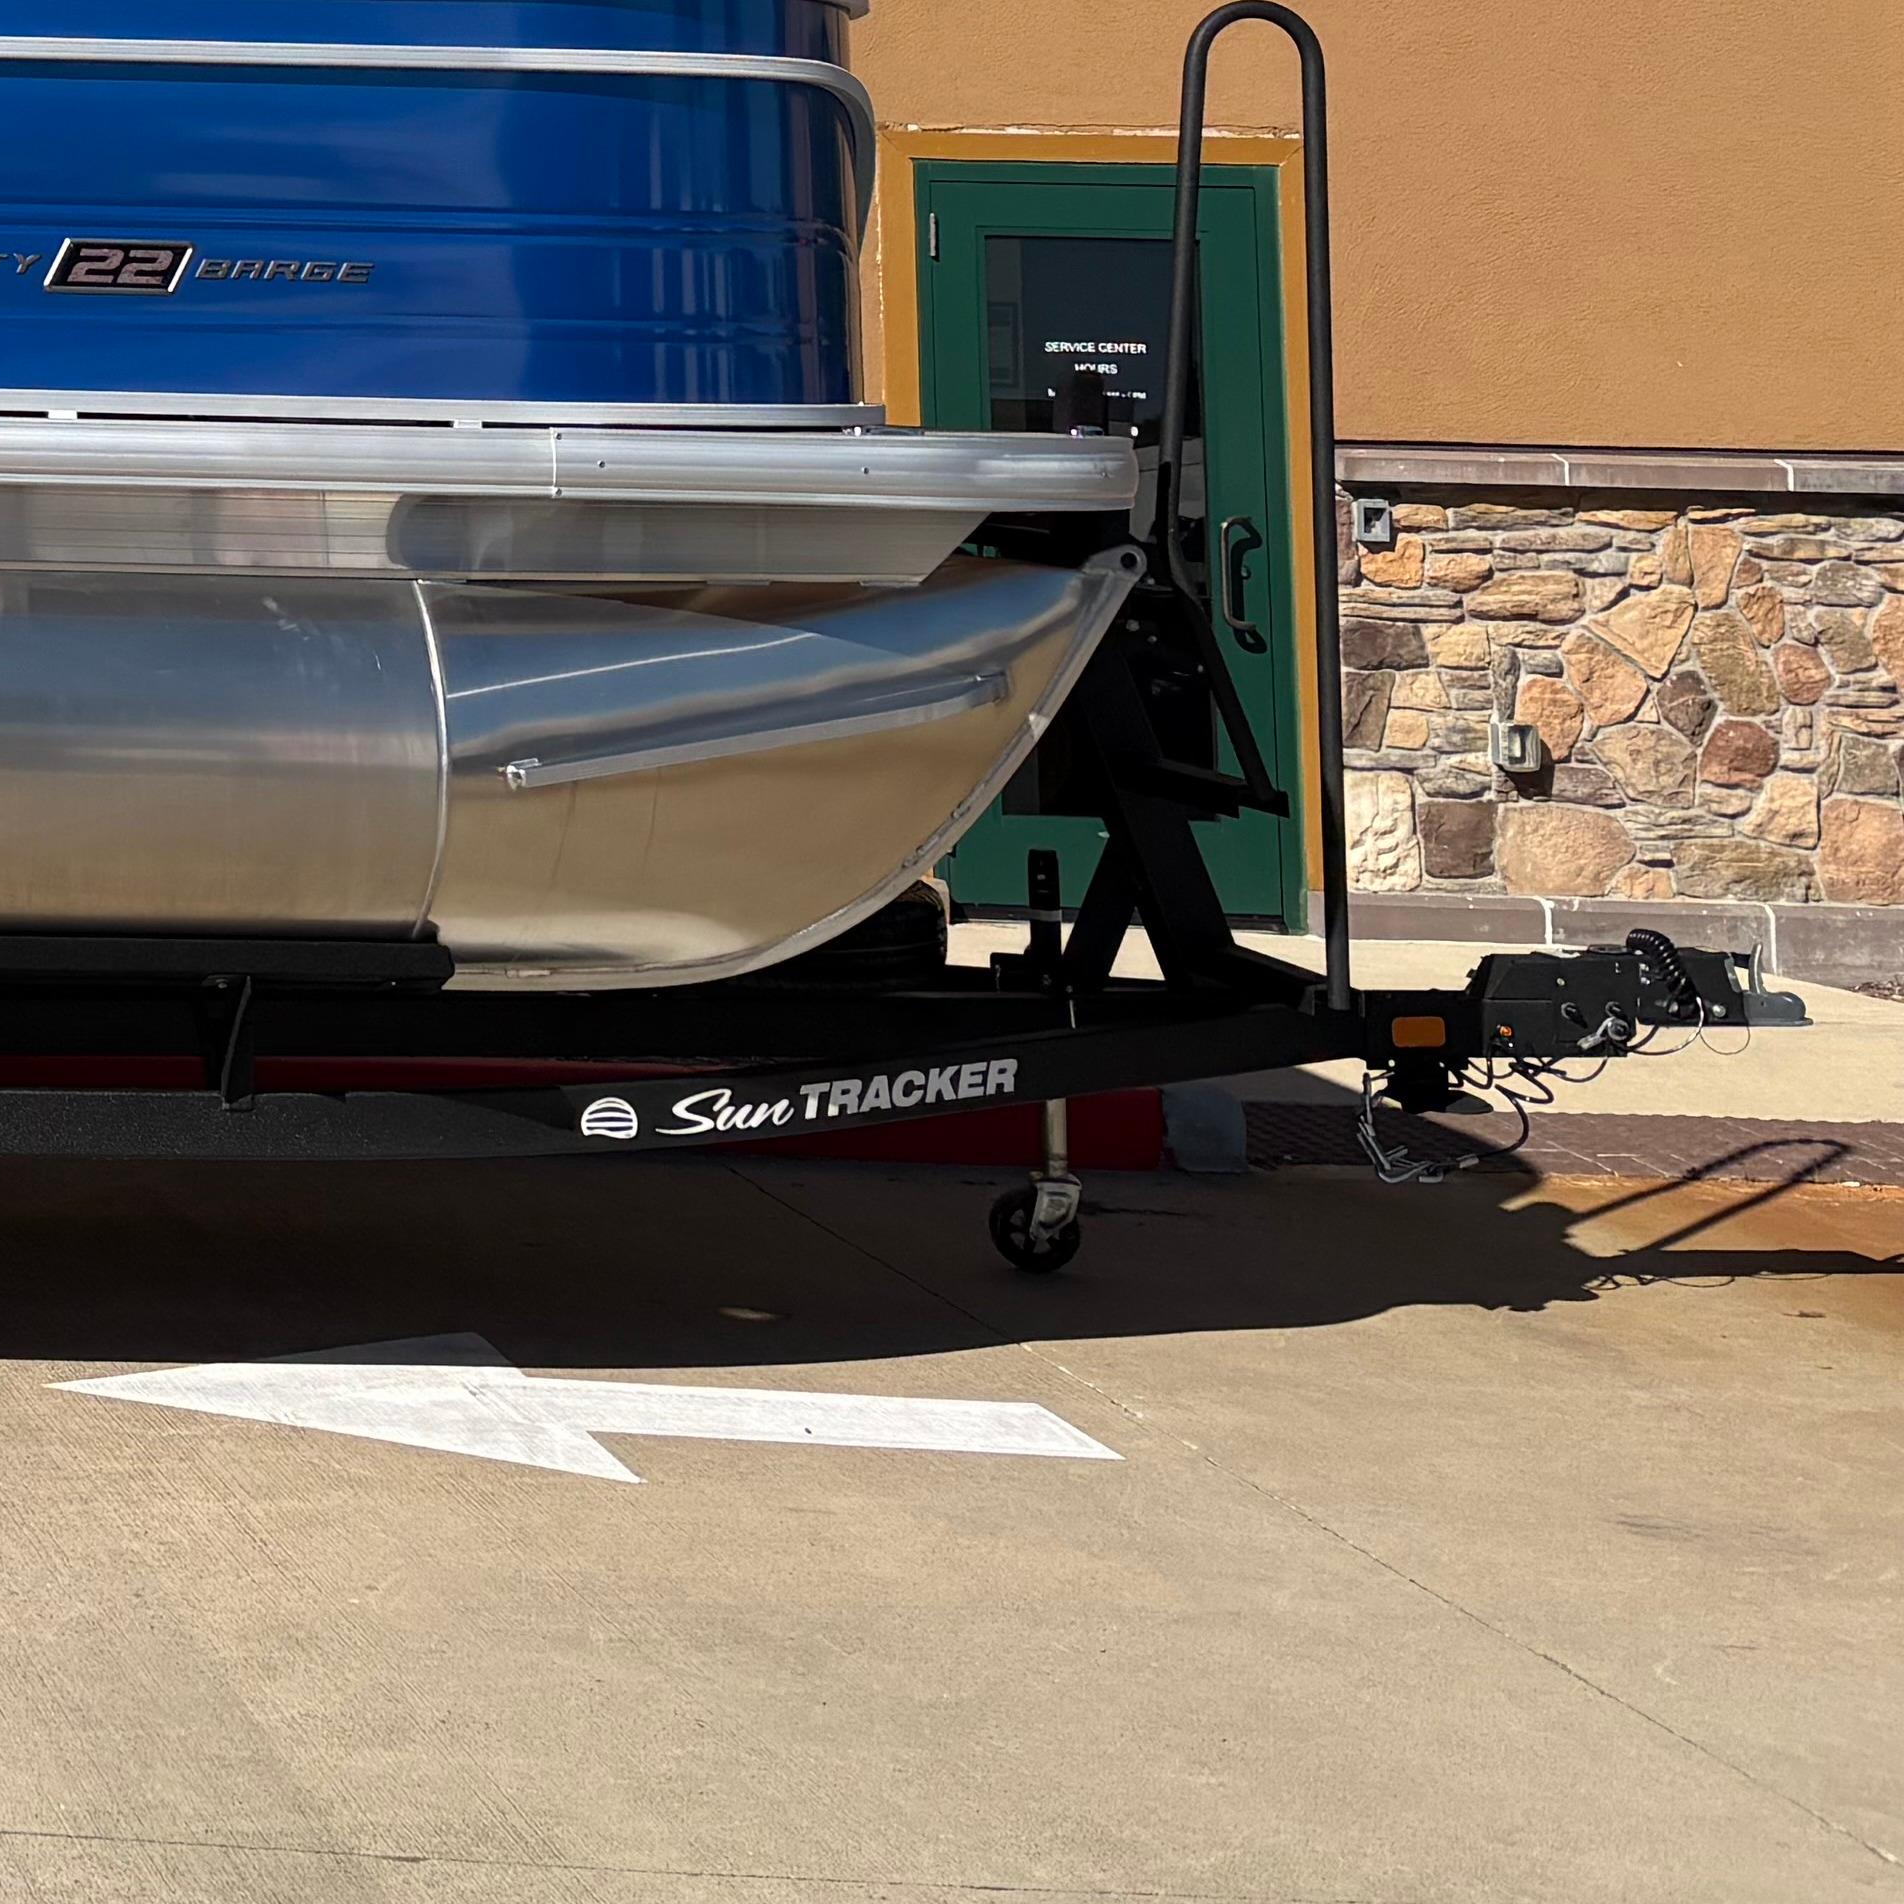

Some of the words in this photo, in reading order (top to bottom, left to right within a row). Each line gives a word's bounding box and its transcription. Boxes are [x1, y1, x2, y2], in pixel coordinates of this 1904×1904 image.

[66, 247, 174, 285] 22
[194, 257, 376, 285] BARGE
[1044, 341, 1096, 353] SERVICE
[1097, 342, 1147, 355] CENTER
[655, 1087, 794, 1136] Sun
[799, 1057, 1019, 1121] TRACKER
